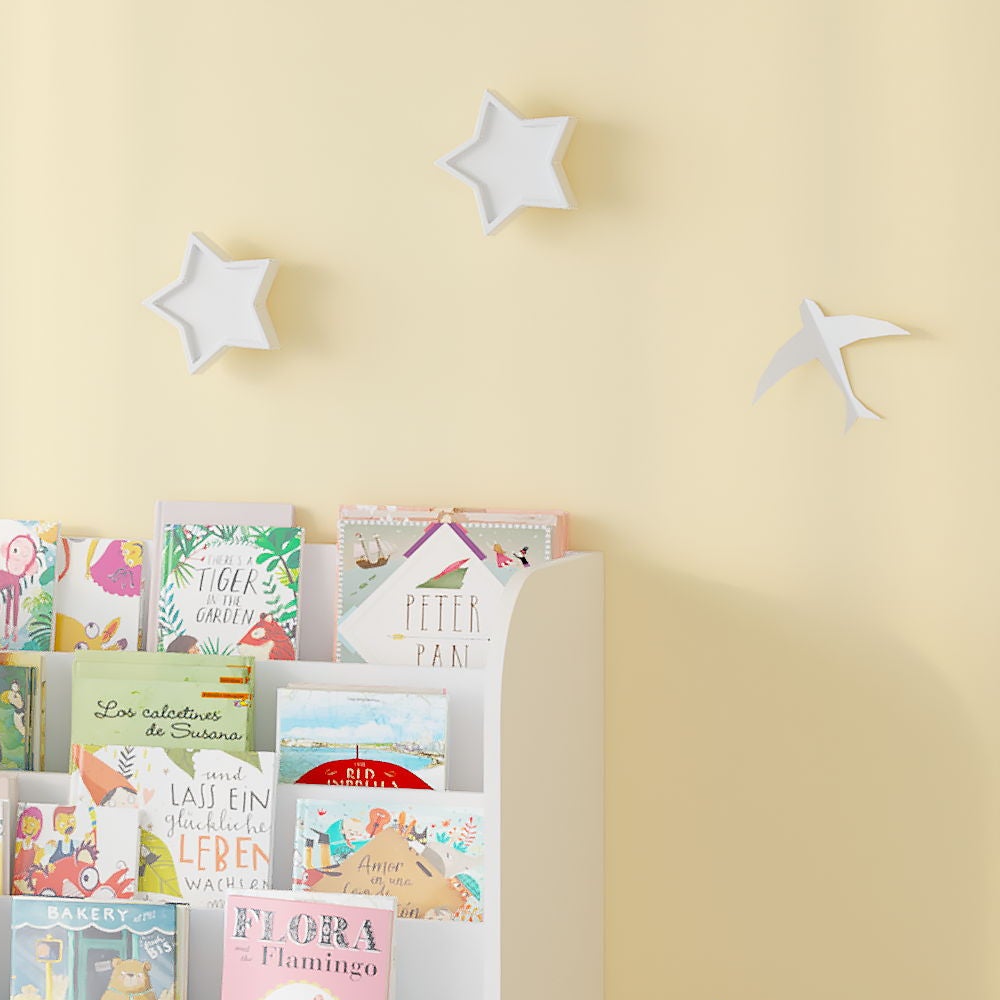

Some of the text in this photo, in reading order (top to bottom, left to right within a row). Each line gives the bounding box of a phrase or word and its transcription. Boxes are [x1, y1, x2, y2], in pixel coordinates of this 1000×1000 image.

[195, 567, 258, 595] TIGER
[196, 607, 255, 625] GARDEN
[405, 593, 480, 633] PETER
[416, 643, 468, 669] PAN
[94, 700, 222, 721] Los calcetines
[145, 722, 243, 741] de Susana
[201, 767, 244, 781] und
[171, 783, 271, 813] LASS EIN
[179, 834, 271, 872] LEBEN
[47, 905, 129, 922] BAKERY
[231, 906, 383, 953] FLORA
[261, 945, 379, 981] Flamingo
